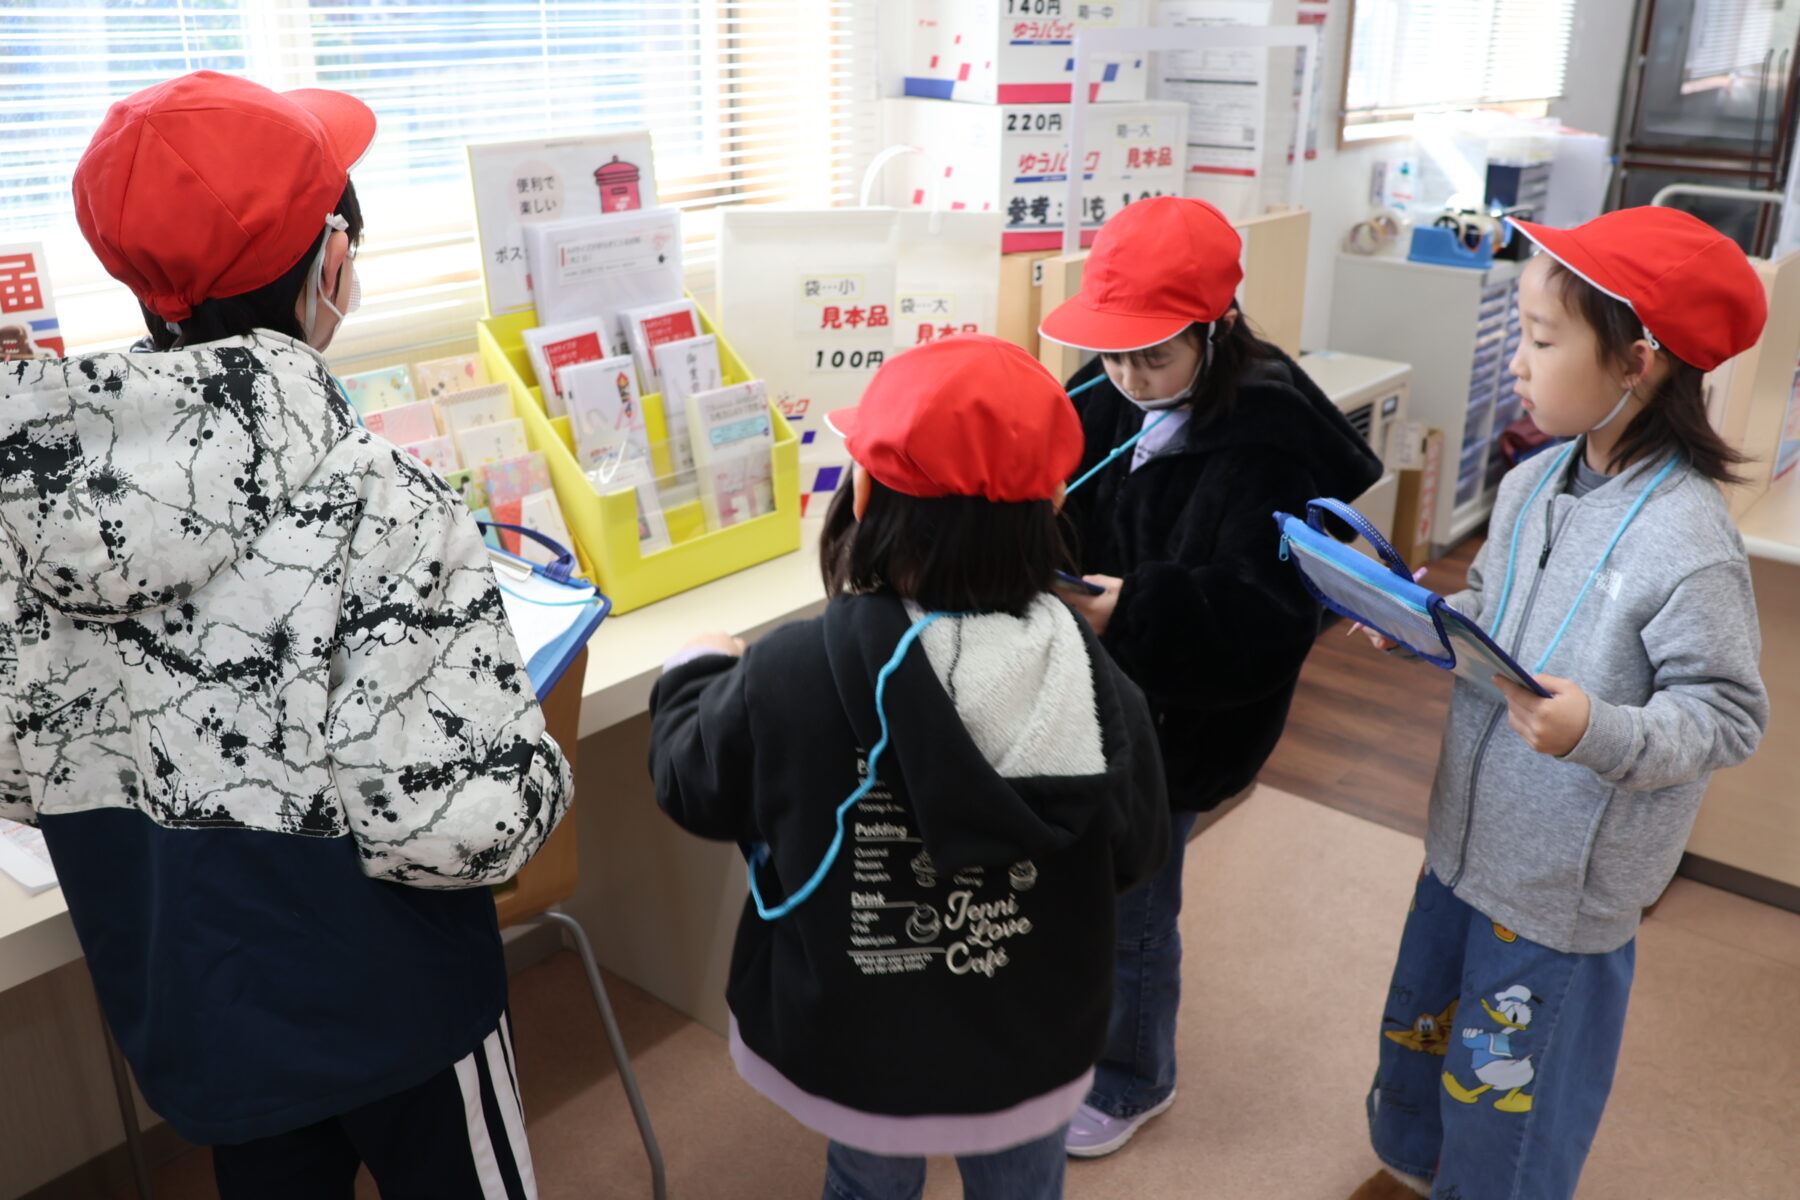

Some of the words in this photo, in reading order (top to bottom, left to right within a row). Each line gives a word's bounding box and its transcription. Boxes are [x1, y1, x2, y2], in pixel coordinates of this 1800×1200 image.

[1007, 0, 1061, 15] 140円
[1007, 113, 1062, 131] 220円
[1018, 151, 1102, 173] ゆうパク
[1126, 147, 1172, 169] 見本品
[516, 175, 555, 194] 便利で
[520, 200, 557, 215] 楽しい
[820, 305, 889, 329] 見本品
[816, 350, 884, 369] 100円
[851, 891, 886, 906] Drink
[944, 890, 1019, 930] Jenni
[966, 916, 1034, 948] Love
